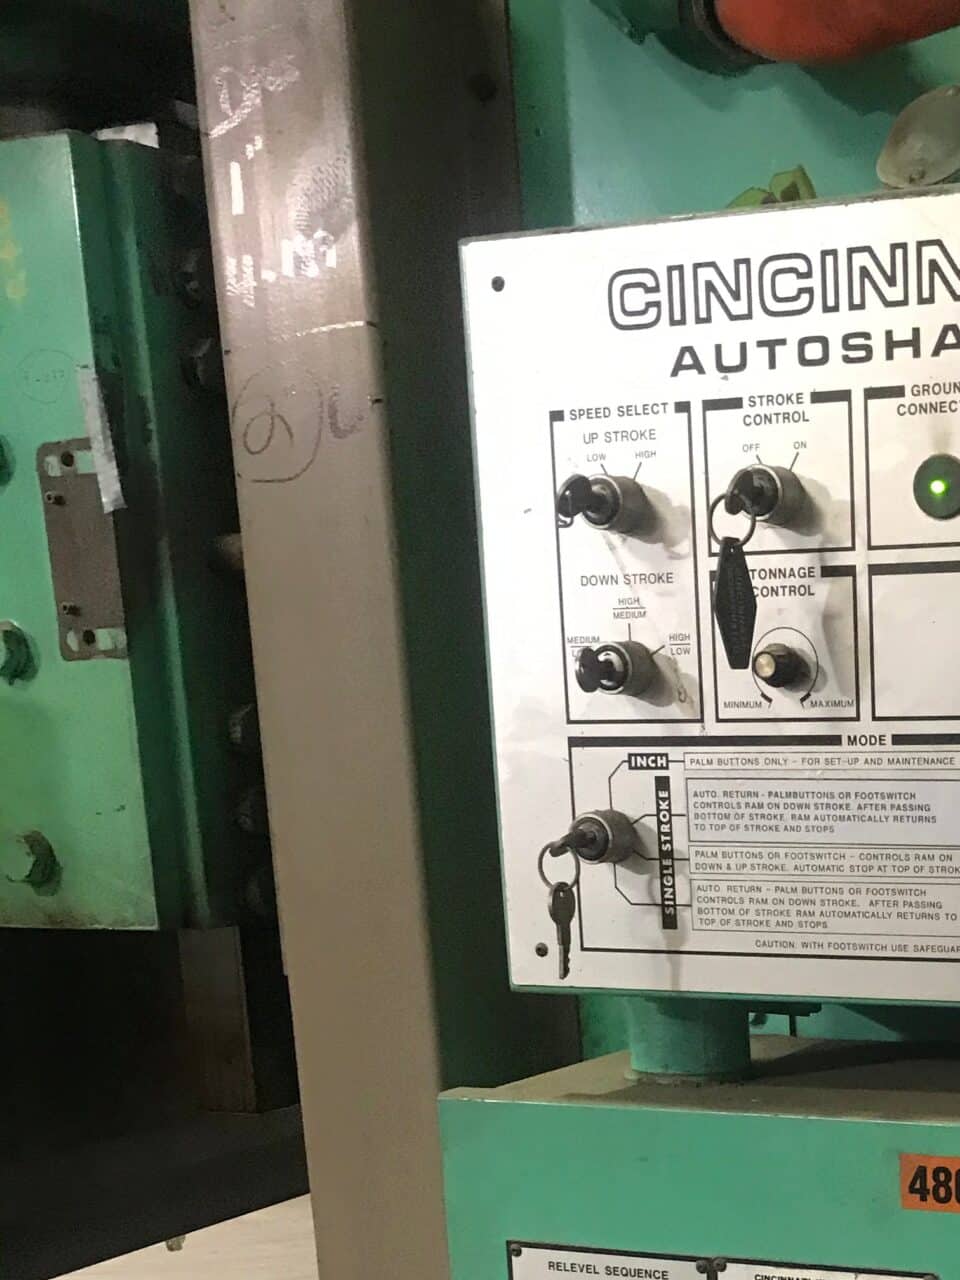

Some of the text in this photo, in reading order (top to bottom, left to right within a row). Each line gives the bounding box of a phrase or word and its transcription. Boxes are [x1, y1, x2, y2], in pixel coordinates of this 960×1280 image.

[748, 392, 805, 408] STROKE
[569, 403, 669, 421] SPEED SELECT
[743, 411, 810, 427] CONTROL
[583, 428, 657, 444] UP STROKE
[742, 443, 761, 452] OFF
[793, 441, 808, 450] ON
[586, 453, 607, 462] LOW
[635, 450, 657, 460] HIGH
[750, 566, 816, 580] TONNAGE
[580, 572, 674, 588] DOWN STROKE
[618, 597, 640, 606] HIGH
[613, 610, 647, 619] MEDIUM
[669, 633, 690, 642] HIGH
[670, 647, 691, 656] LOW
[723, 700, 762, 708] MINIMUM
[810, 700, 854, 708] MAXIMUM
[847, 734, 887, 746] MODE
[631, 756, 668, 768] INCH
[689, 757, 954, 766] PALM BUTTONS ONLY FOR AND MAINTENANCE
[722, 790, 916, 800] RETURN PALMBUTTONS FOOTSWITCH
[692, 801, 930, 812] CONTROLS RAM DOWN AFTER PASSING
[693, 812, 936, 824] BOTTOM RAM AUTOMATICALLY RETURNS
[709, 824, 834, 833] TOP STROKE AND STOPS
[658, 790, 675, 915] SINGLE STROKE
[694, 850, 934, 862] PALM BUTTONS FOOTSWITCH CONTROLS RAM
[694, 862, 910, 873] DOWN & AUTOMATIC STOP TOP
[548, 1261, 668, 1280] RELEVEL SEQUENCE
